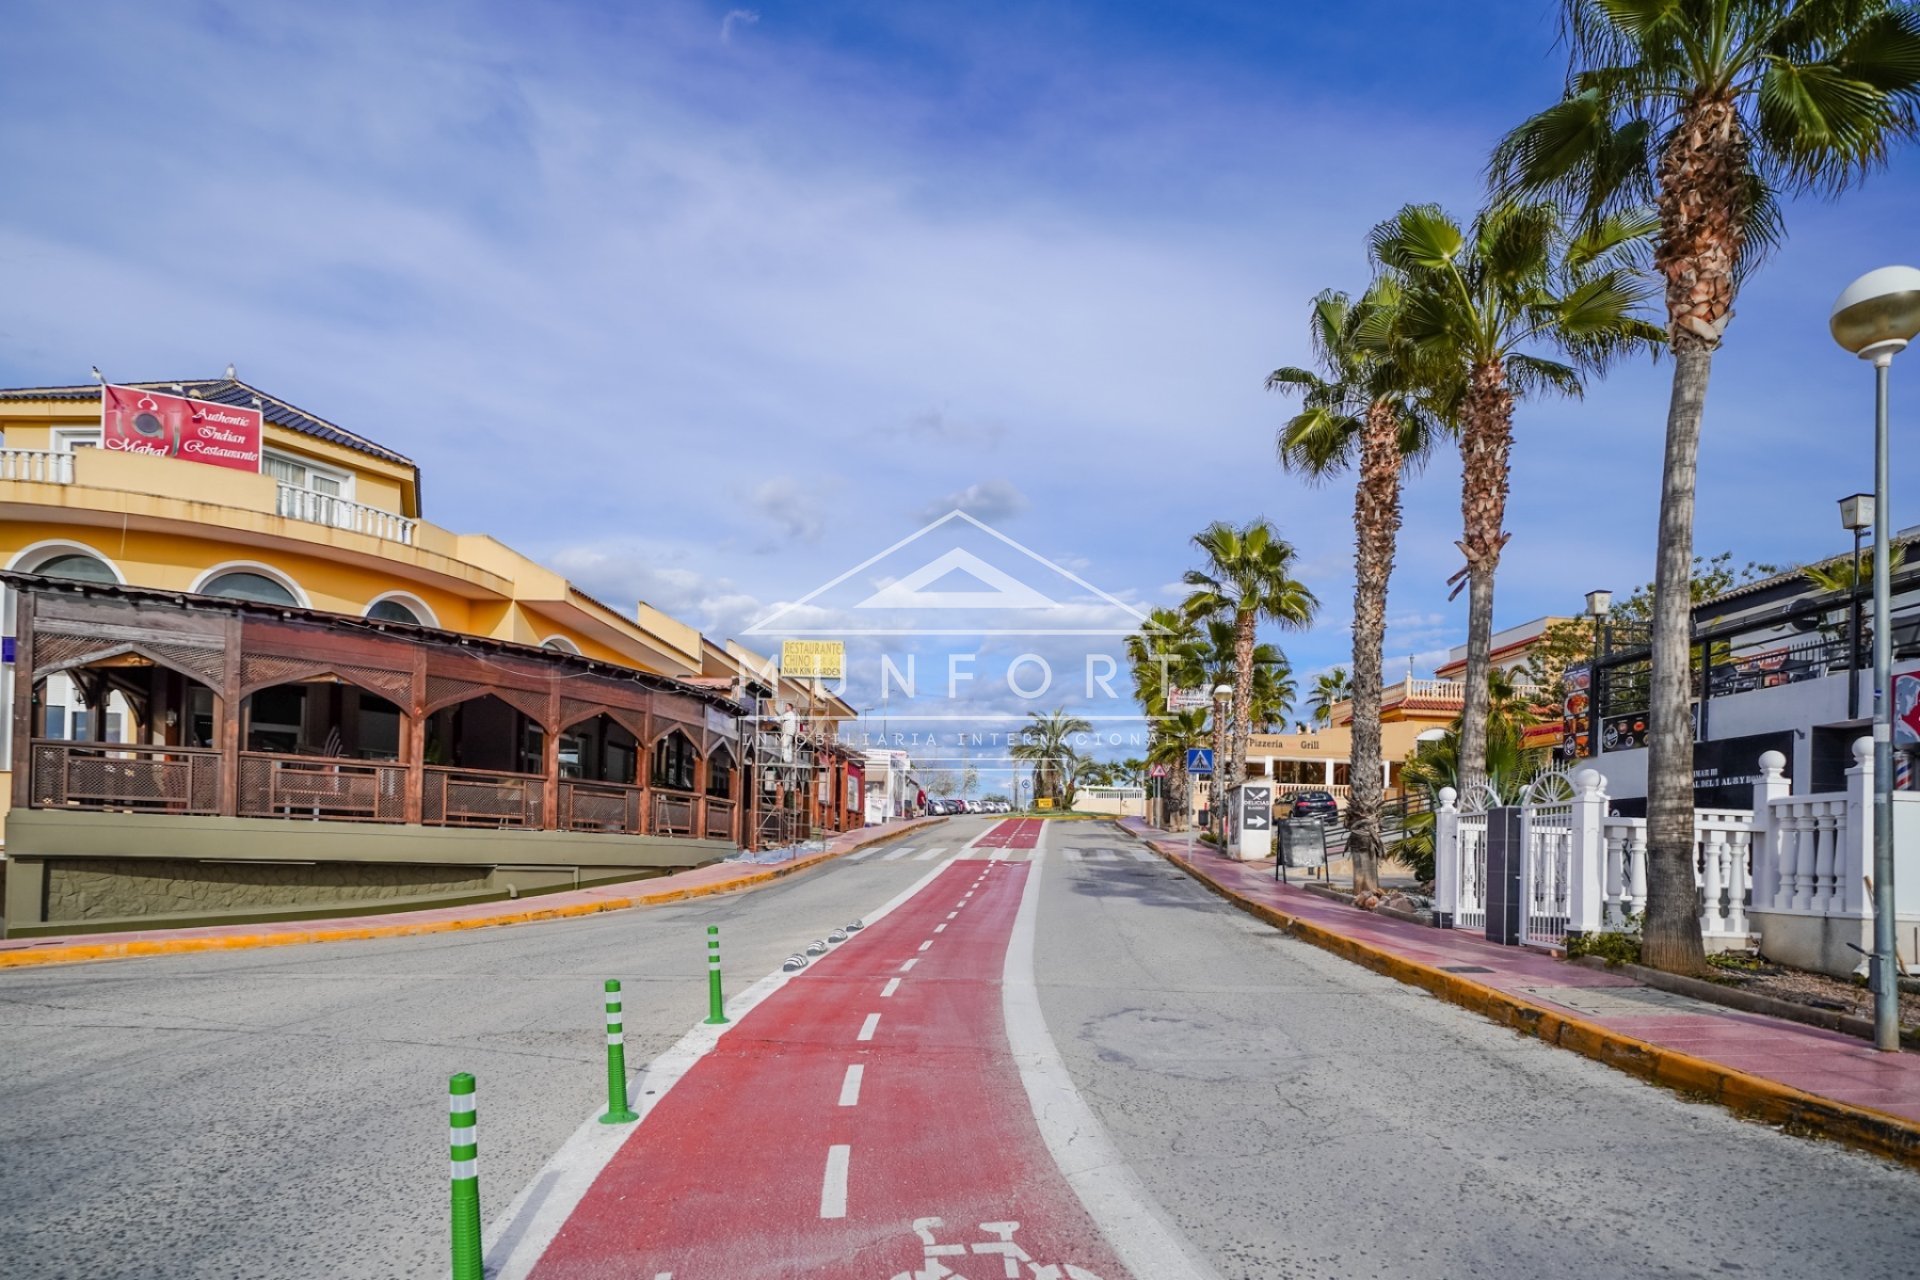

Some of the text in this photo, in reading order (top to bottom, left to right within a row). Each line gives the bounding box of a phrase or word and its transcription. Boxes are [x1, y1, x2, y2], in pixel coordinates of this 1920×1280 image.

[192, 407, 249, 427] Authentic
[197, 426, 246, 444] Indian
[106, 438, 169, 458] Mahal
[784, 642, 842, 655] RESTAURANTE
[784, 655, 811, 667] CHINO
[1249, 739, 1283, 749] Pizzeria
[1300, 741, 1320, 750] Grill
